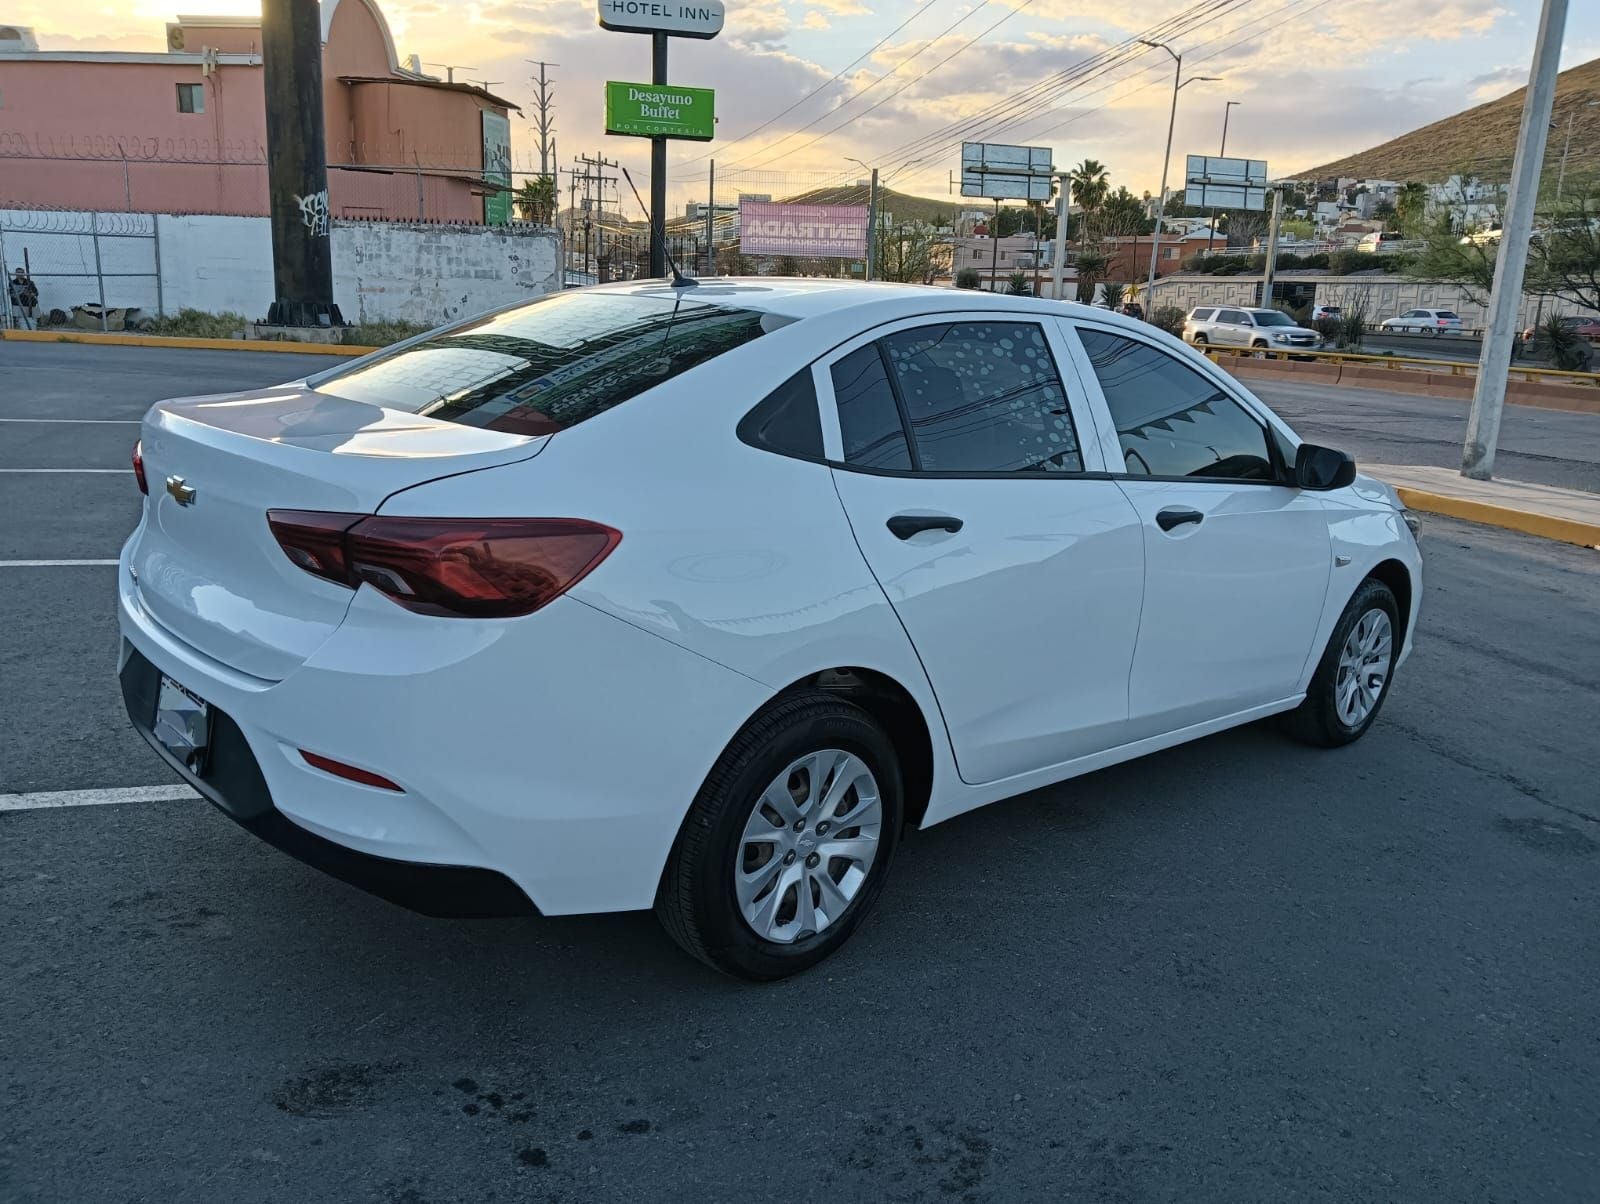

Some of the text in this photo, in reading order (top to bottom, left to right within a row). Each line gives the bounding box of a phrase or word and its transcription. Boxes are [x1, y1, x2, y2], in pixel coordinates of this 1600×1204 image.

[613, 0, 710, 20] HOTEL INN
[628, 88, 693, 106] Desayuno
[640, 103, 680, 119] Buffet
